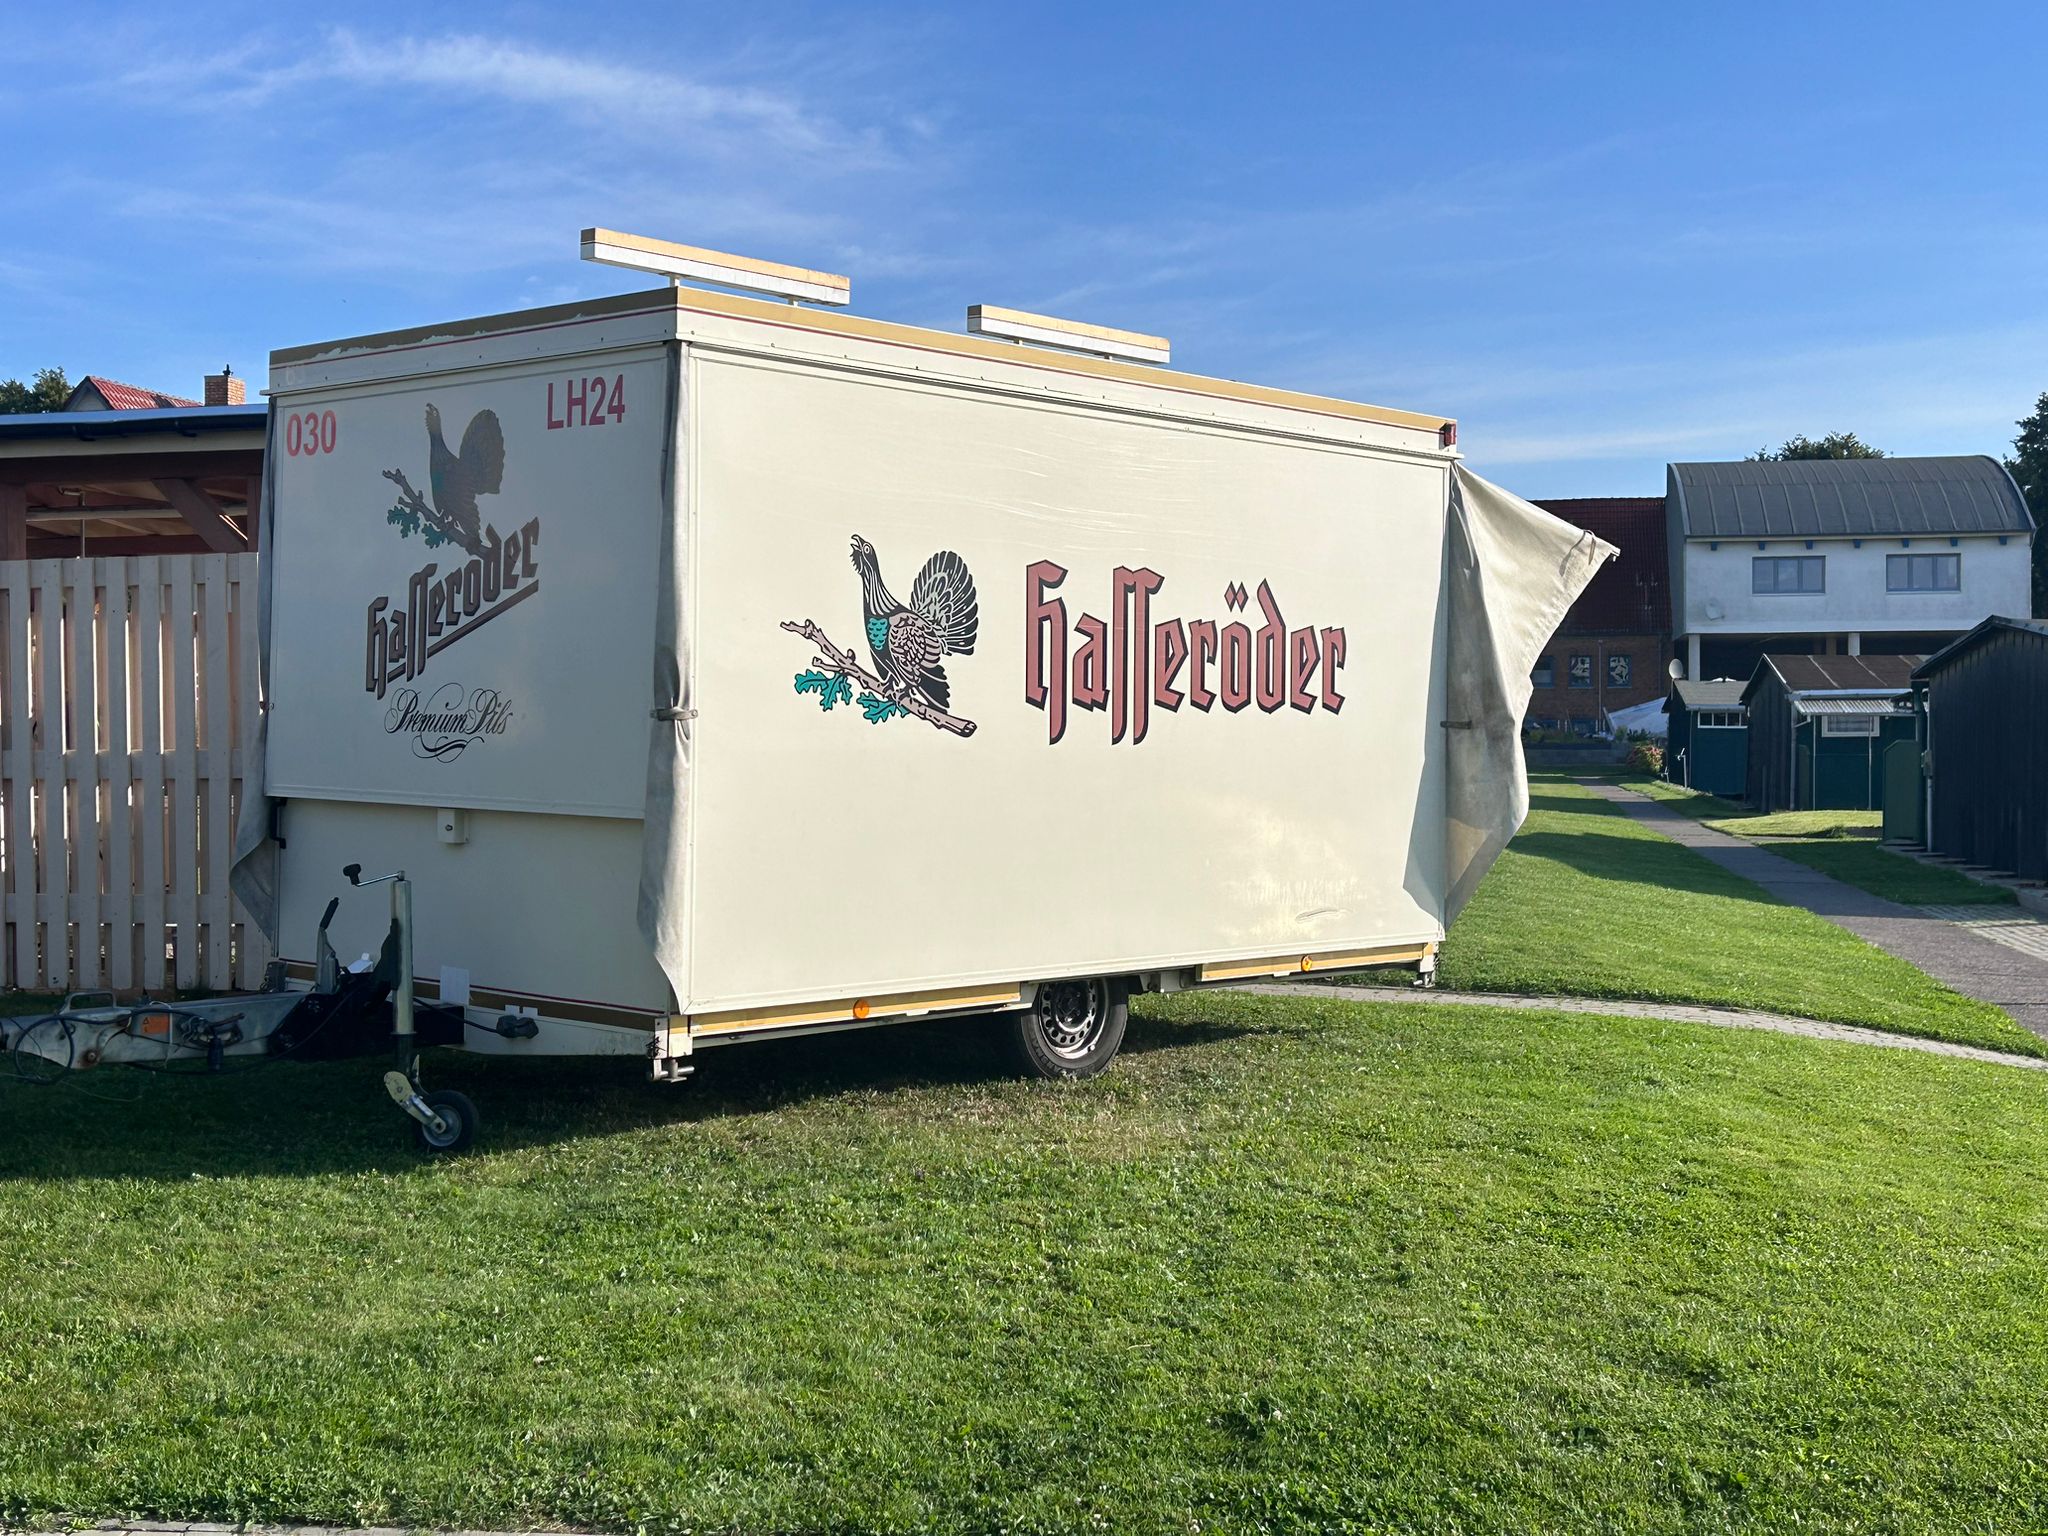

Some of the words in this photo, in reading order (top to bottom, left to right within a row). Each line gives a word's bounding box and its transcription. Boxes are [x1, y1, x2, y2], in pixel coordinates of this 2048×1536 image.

[547, 374, 625, 430] LH24
[286, 410, 336, 457] 030
[384, 683, 469, 736] Premium
[464, 688, 513, 735] Pils
